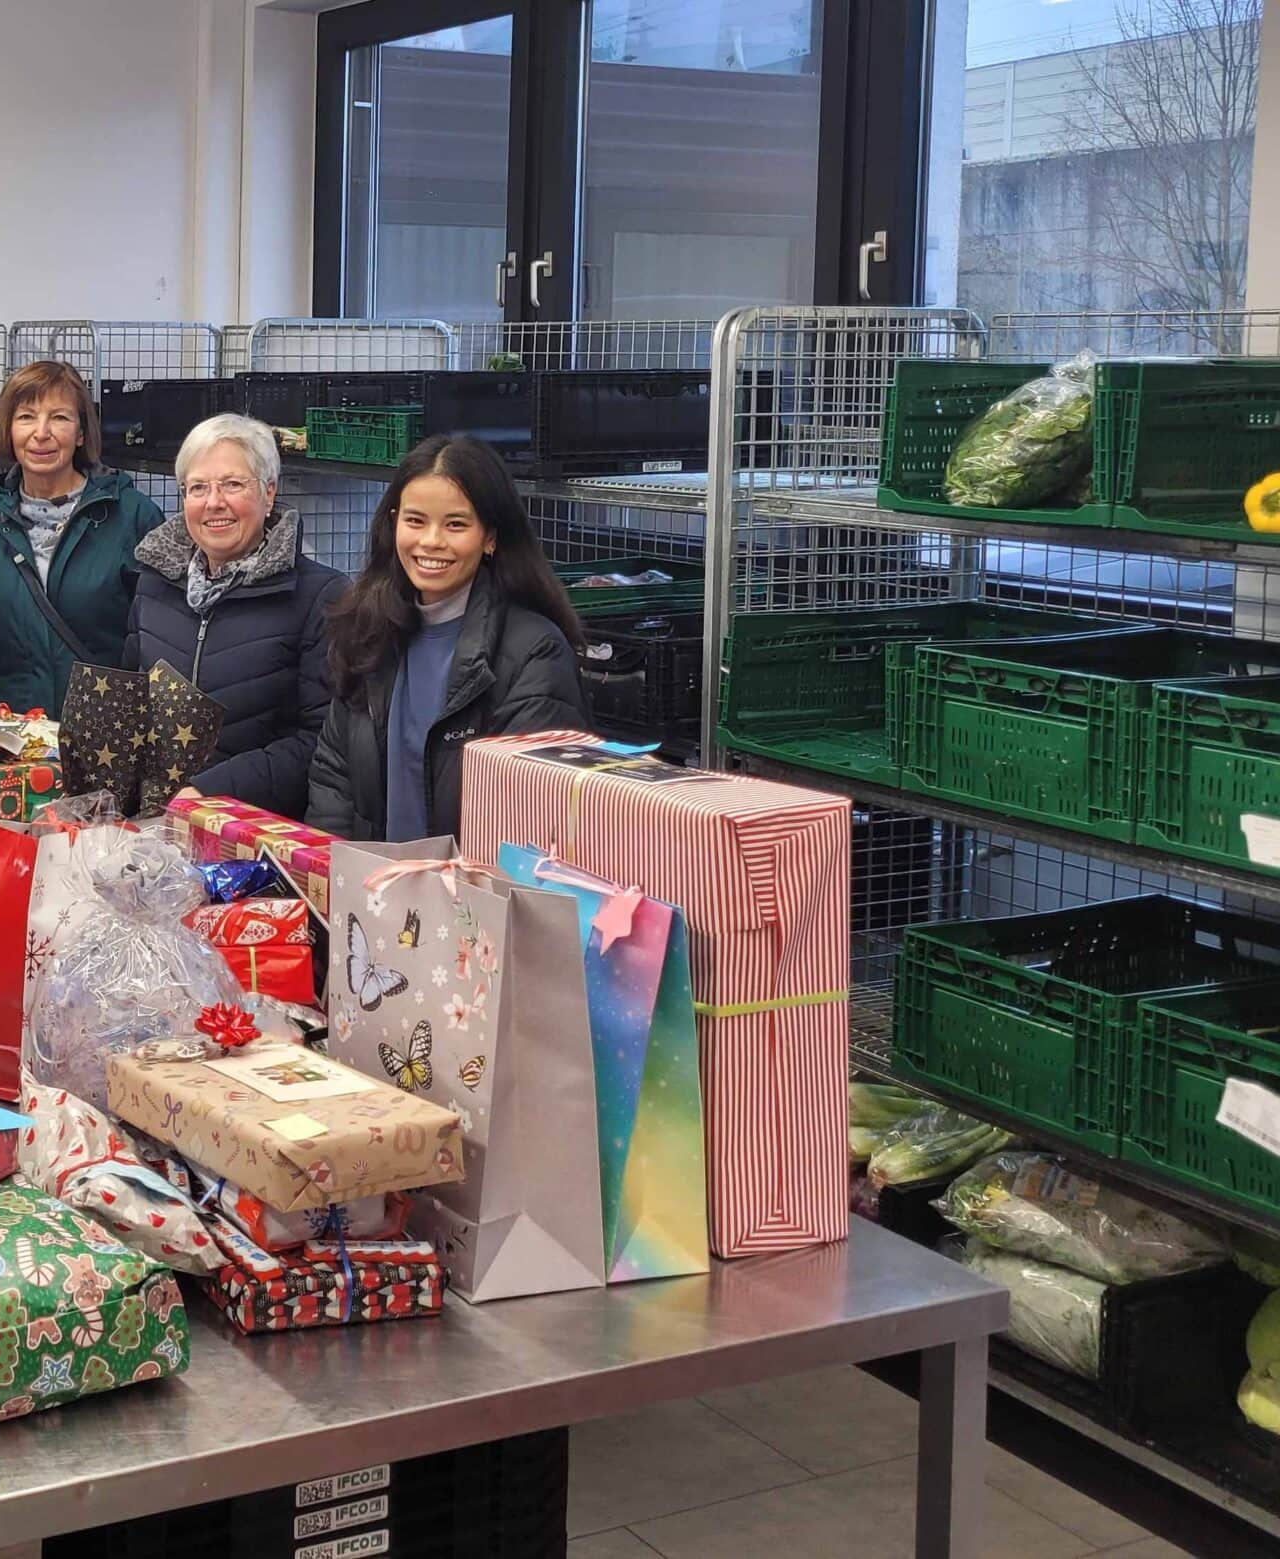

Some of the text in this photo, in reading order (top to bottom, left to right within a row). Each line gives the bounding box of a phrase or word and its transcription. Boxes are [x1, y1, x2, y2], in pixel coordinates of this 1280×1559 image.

[337, 1471, 370, 1490] IFCO
[336, 1502, 369, 1521] IFCO
[337, 1537, 370, 1555] IFCO
